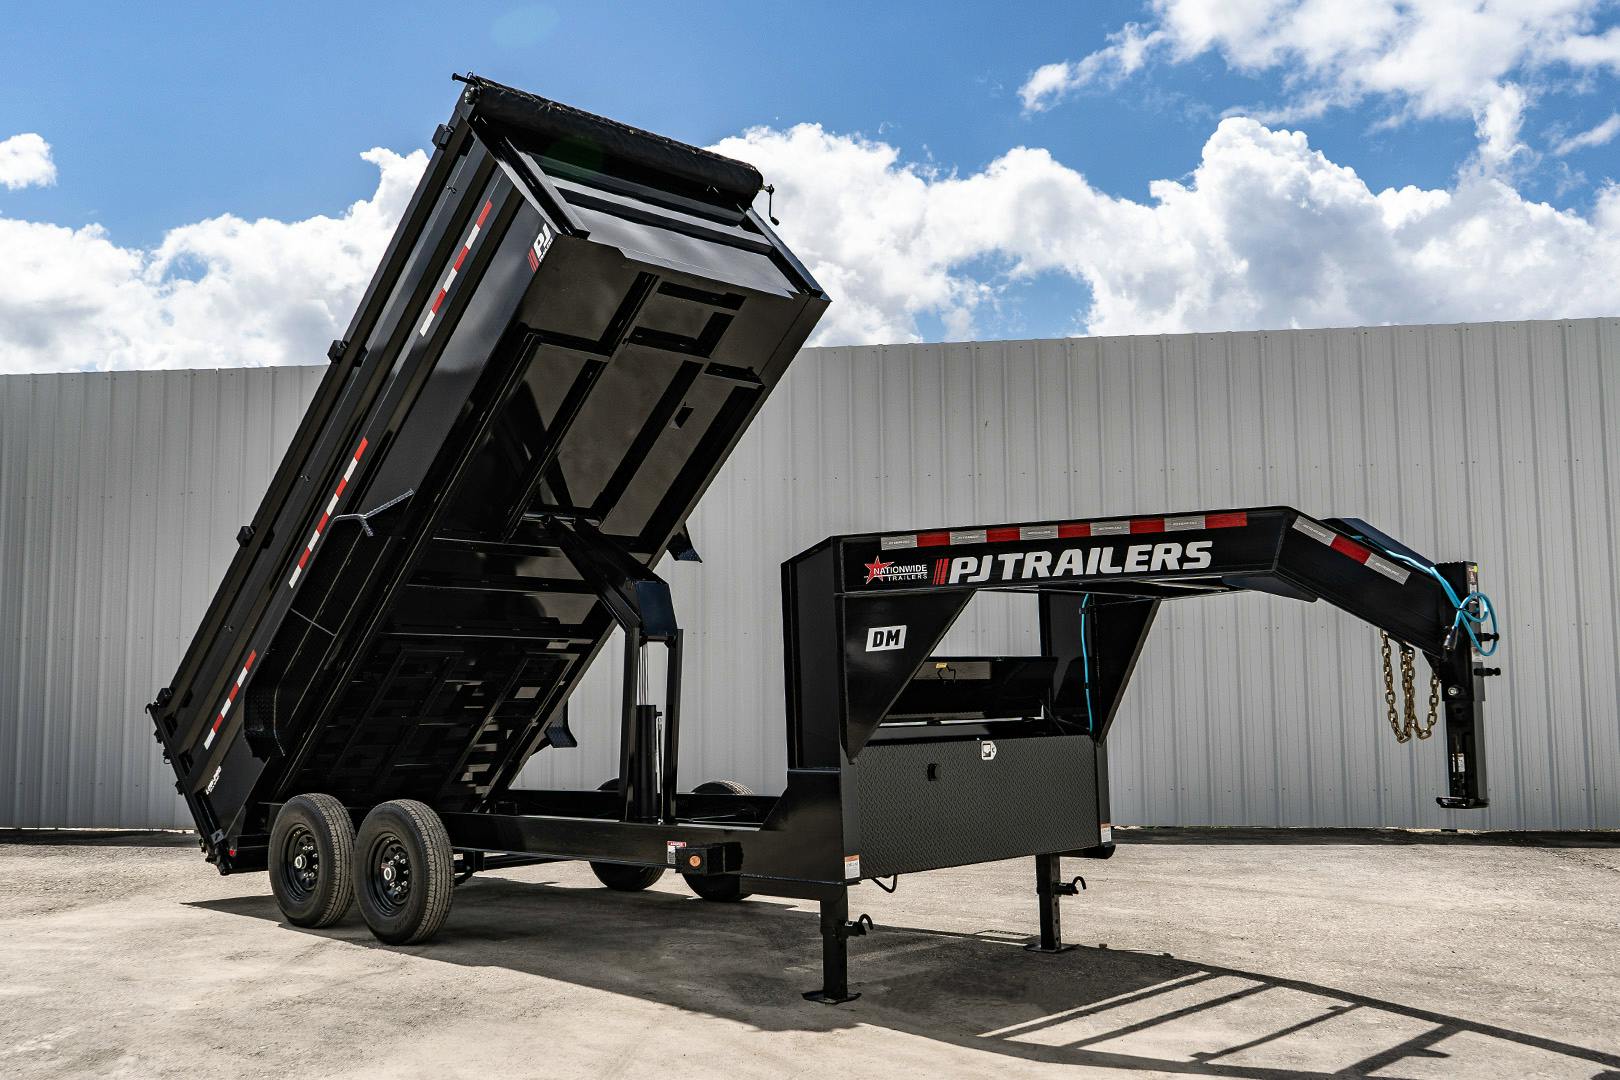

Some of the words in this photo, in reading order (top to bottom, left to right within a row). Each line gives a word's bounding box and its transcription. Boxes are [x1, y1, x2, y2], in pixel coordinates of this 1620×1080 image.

[533, 222, 551, 259] PJ
[873, 564, 928, 575] NATIONWIDE
[999, 541, 1213, 580] TRAILERS
[888, 573, 928, 582] TRAILERS
[872, 629, 901, 648] DM
